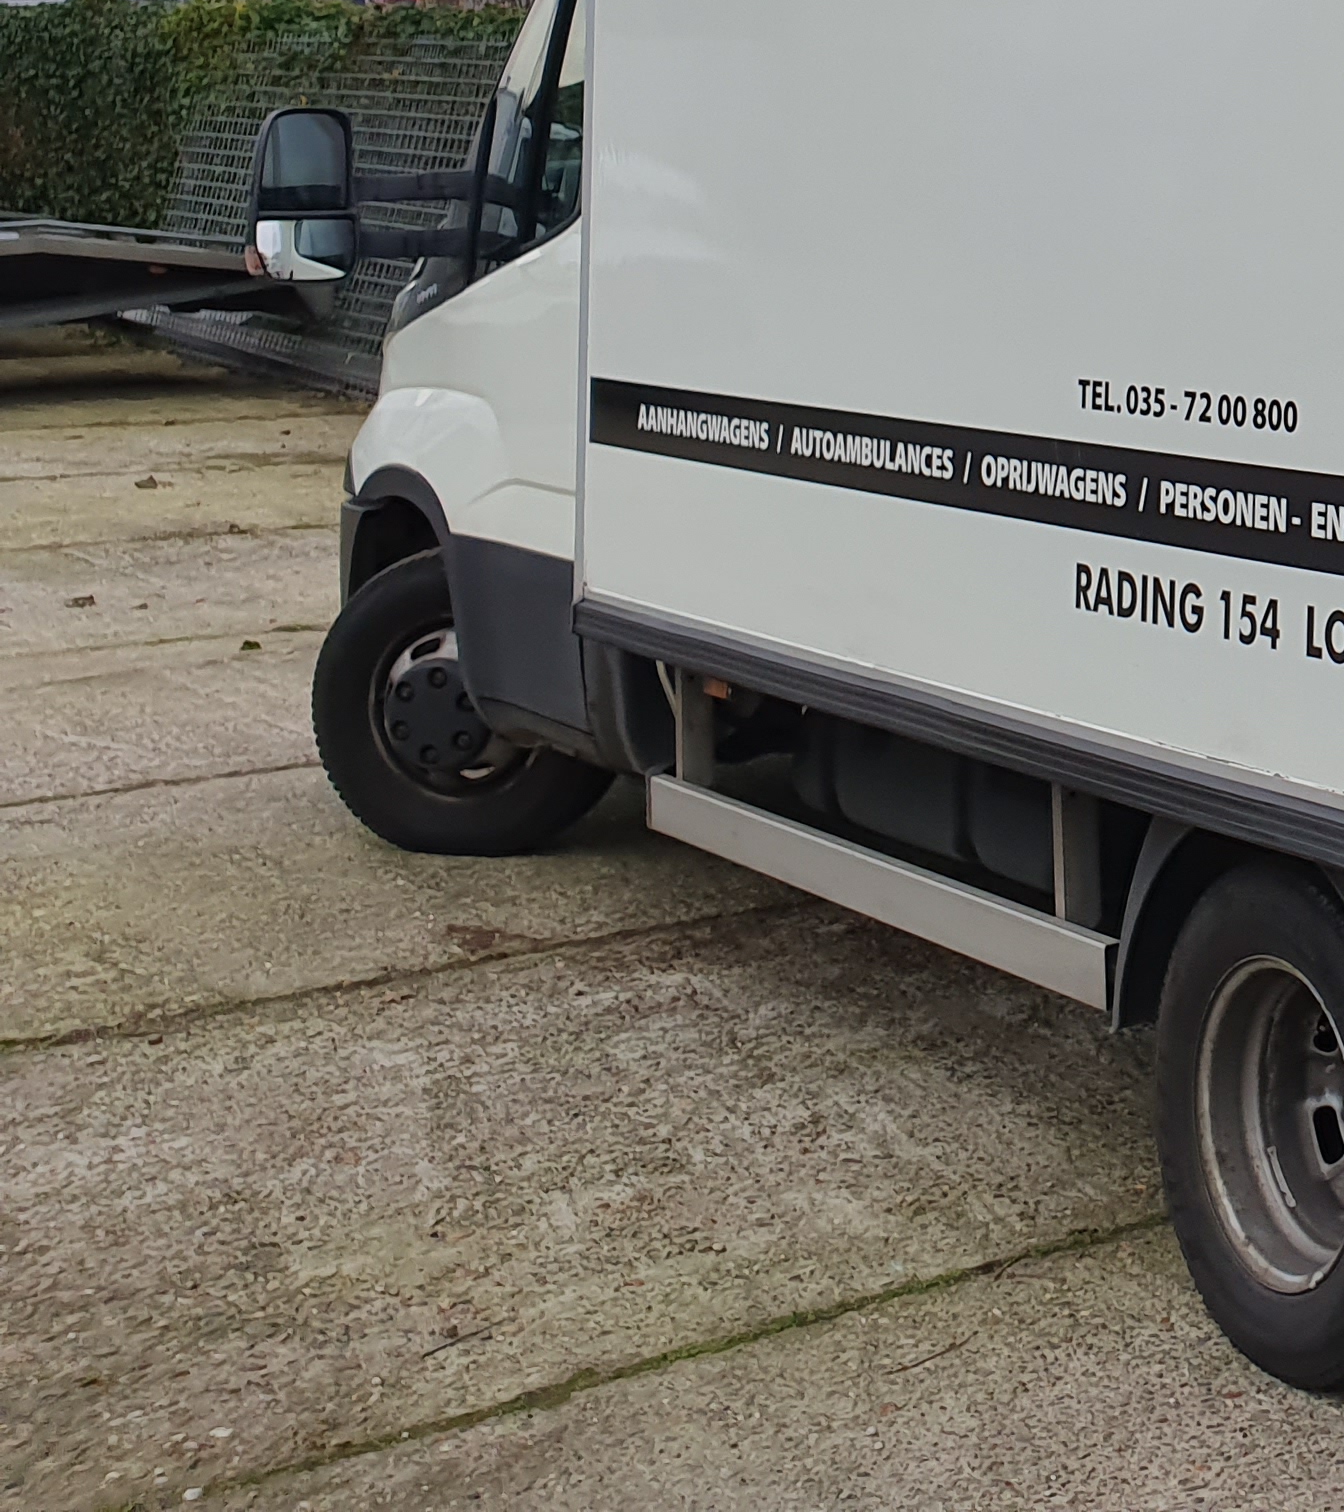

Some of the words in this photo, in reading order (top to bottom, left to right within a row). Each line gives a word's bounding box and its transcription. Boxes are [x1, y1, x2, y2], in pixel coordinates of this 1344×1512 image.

[637, 403, 769, 451] AANHANGWAGENS
[791, 426, 954, 480] AUTOAMBULANCES
[981, 454, 1127, 508] OPRIJWAGENS
[1075, 562, 1205, 633] RADING
[1220, 590, 1281, 650] 154
